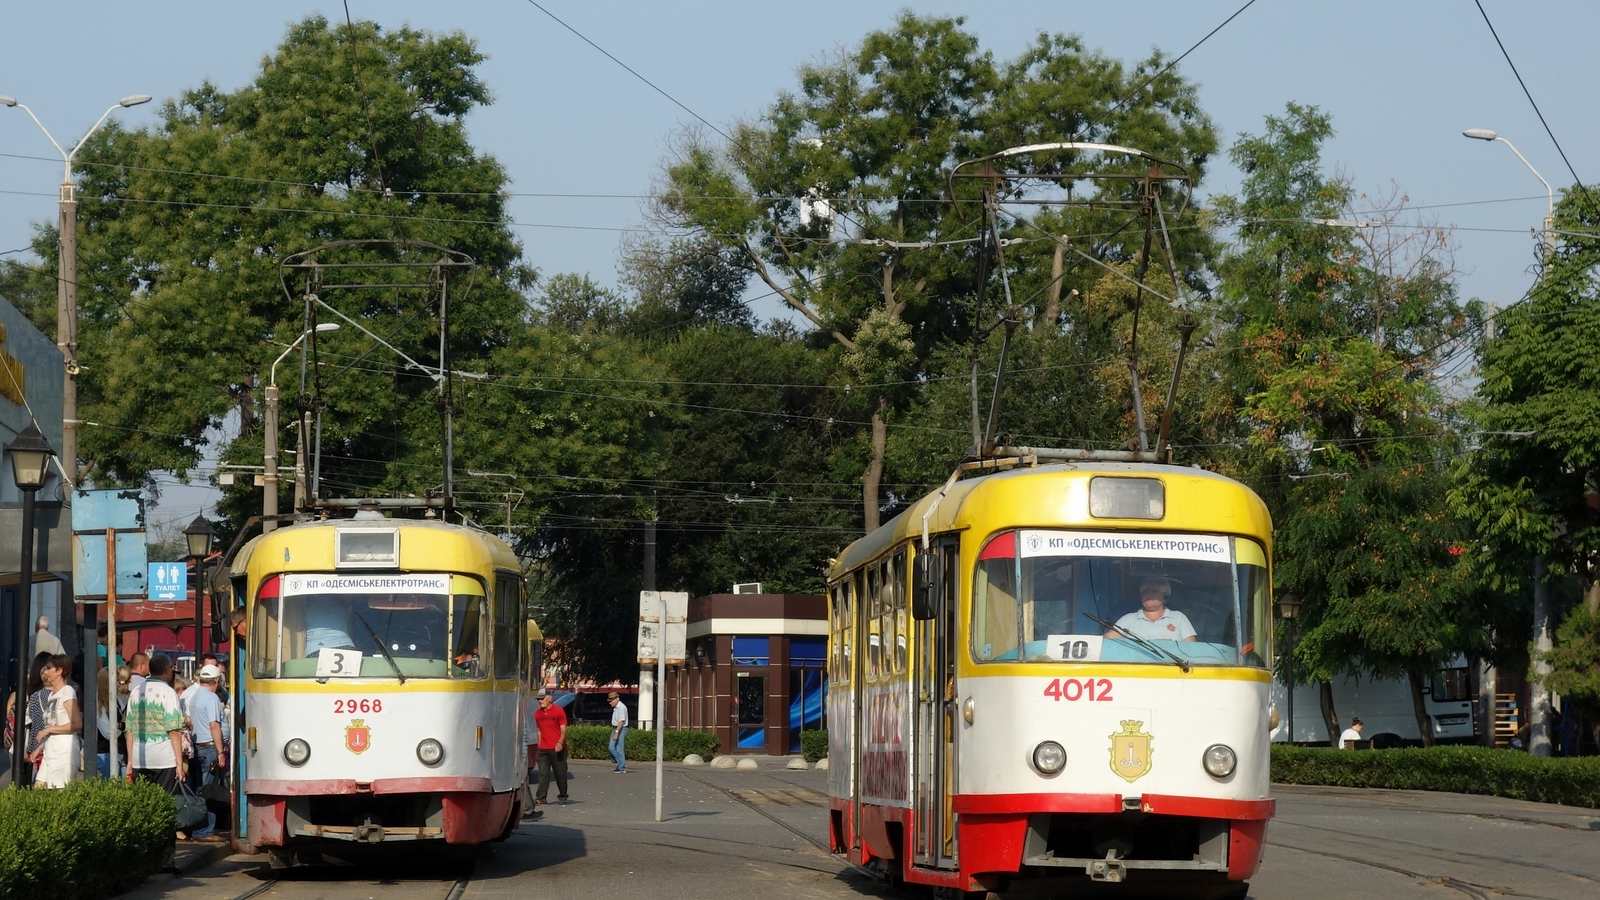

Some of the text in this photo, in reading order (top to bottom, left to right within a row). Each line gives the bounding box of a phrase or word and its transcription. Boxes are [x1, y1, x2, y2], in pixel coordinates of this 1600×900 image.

[1049, 538, 1225, 554] КП «ОДЕСМІСЬКЕЛЕКТРОТРАНС»
[306, 578, 445, 589] КП «ОДЕСМІСЬКЕЛЕКТРОТРАНС»
[1059, 640, 1089, 659] 10
[330, 652, 345, 674] 3
[1043, 678, 1113, 701] 4012
[334, 699, 382, 714] 2968
